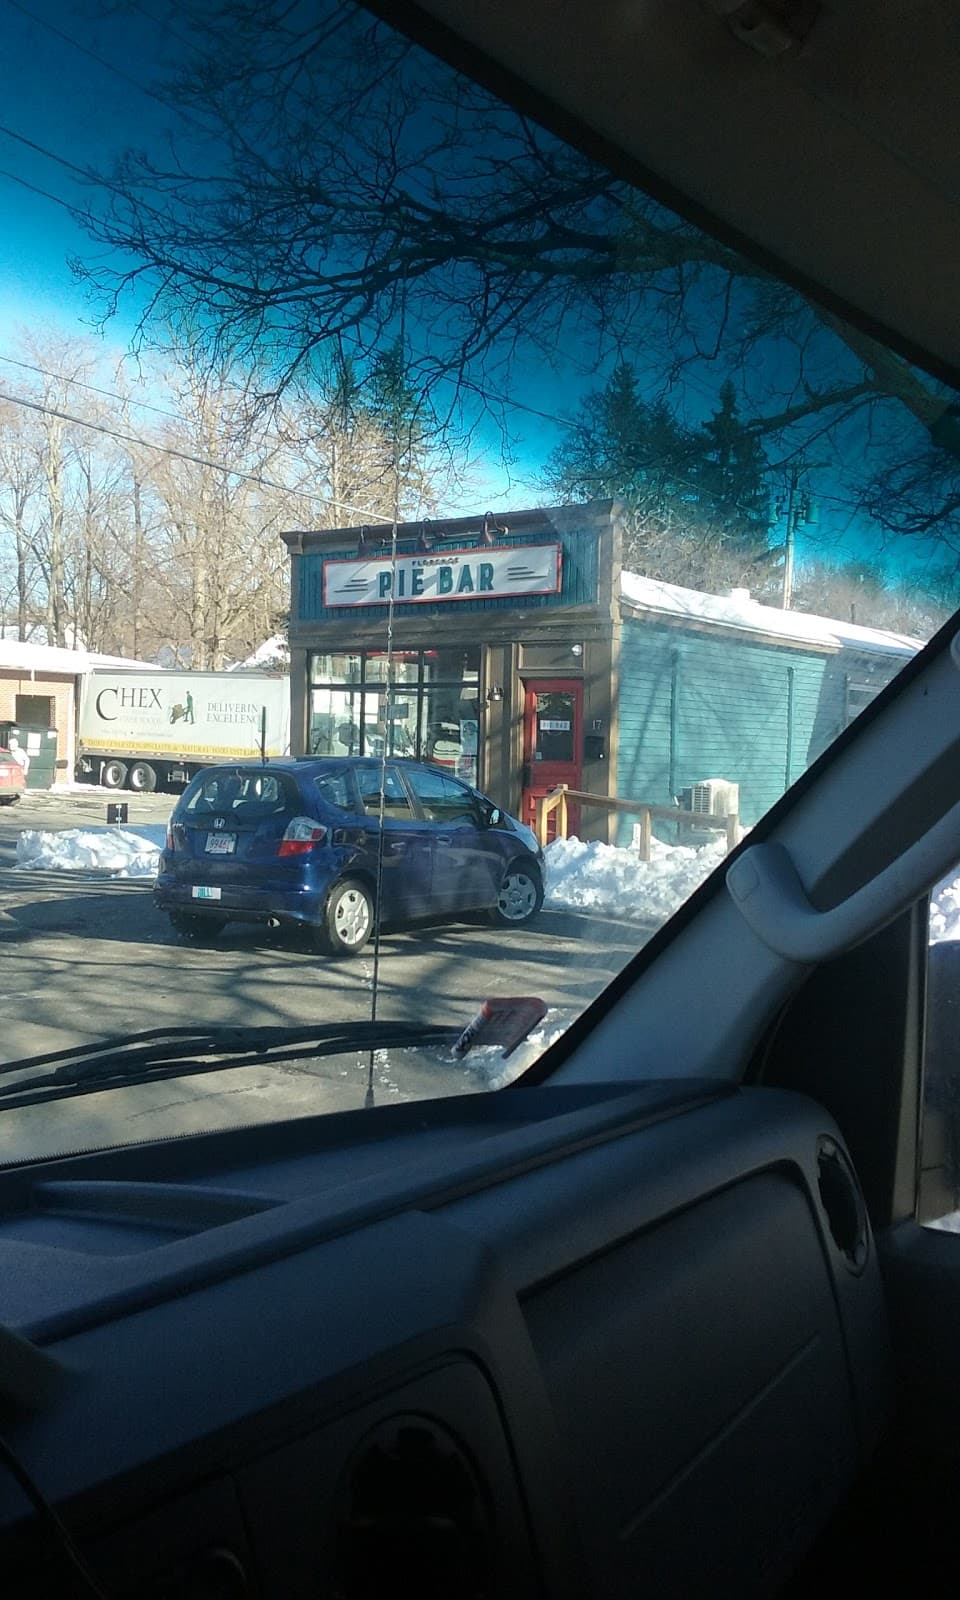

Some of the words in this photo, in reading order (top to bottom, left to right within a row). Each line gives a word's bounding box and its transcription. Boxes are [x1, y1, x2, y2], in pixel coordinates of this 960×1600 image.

[378, 568, 425, 598] PIE
[438, 562, 496, 595] BAR
[95, 686, 164, 721] CHEX
[207, 702, 261, 713] DELIVERIN
[592, 719, 602, 731] 17
